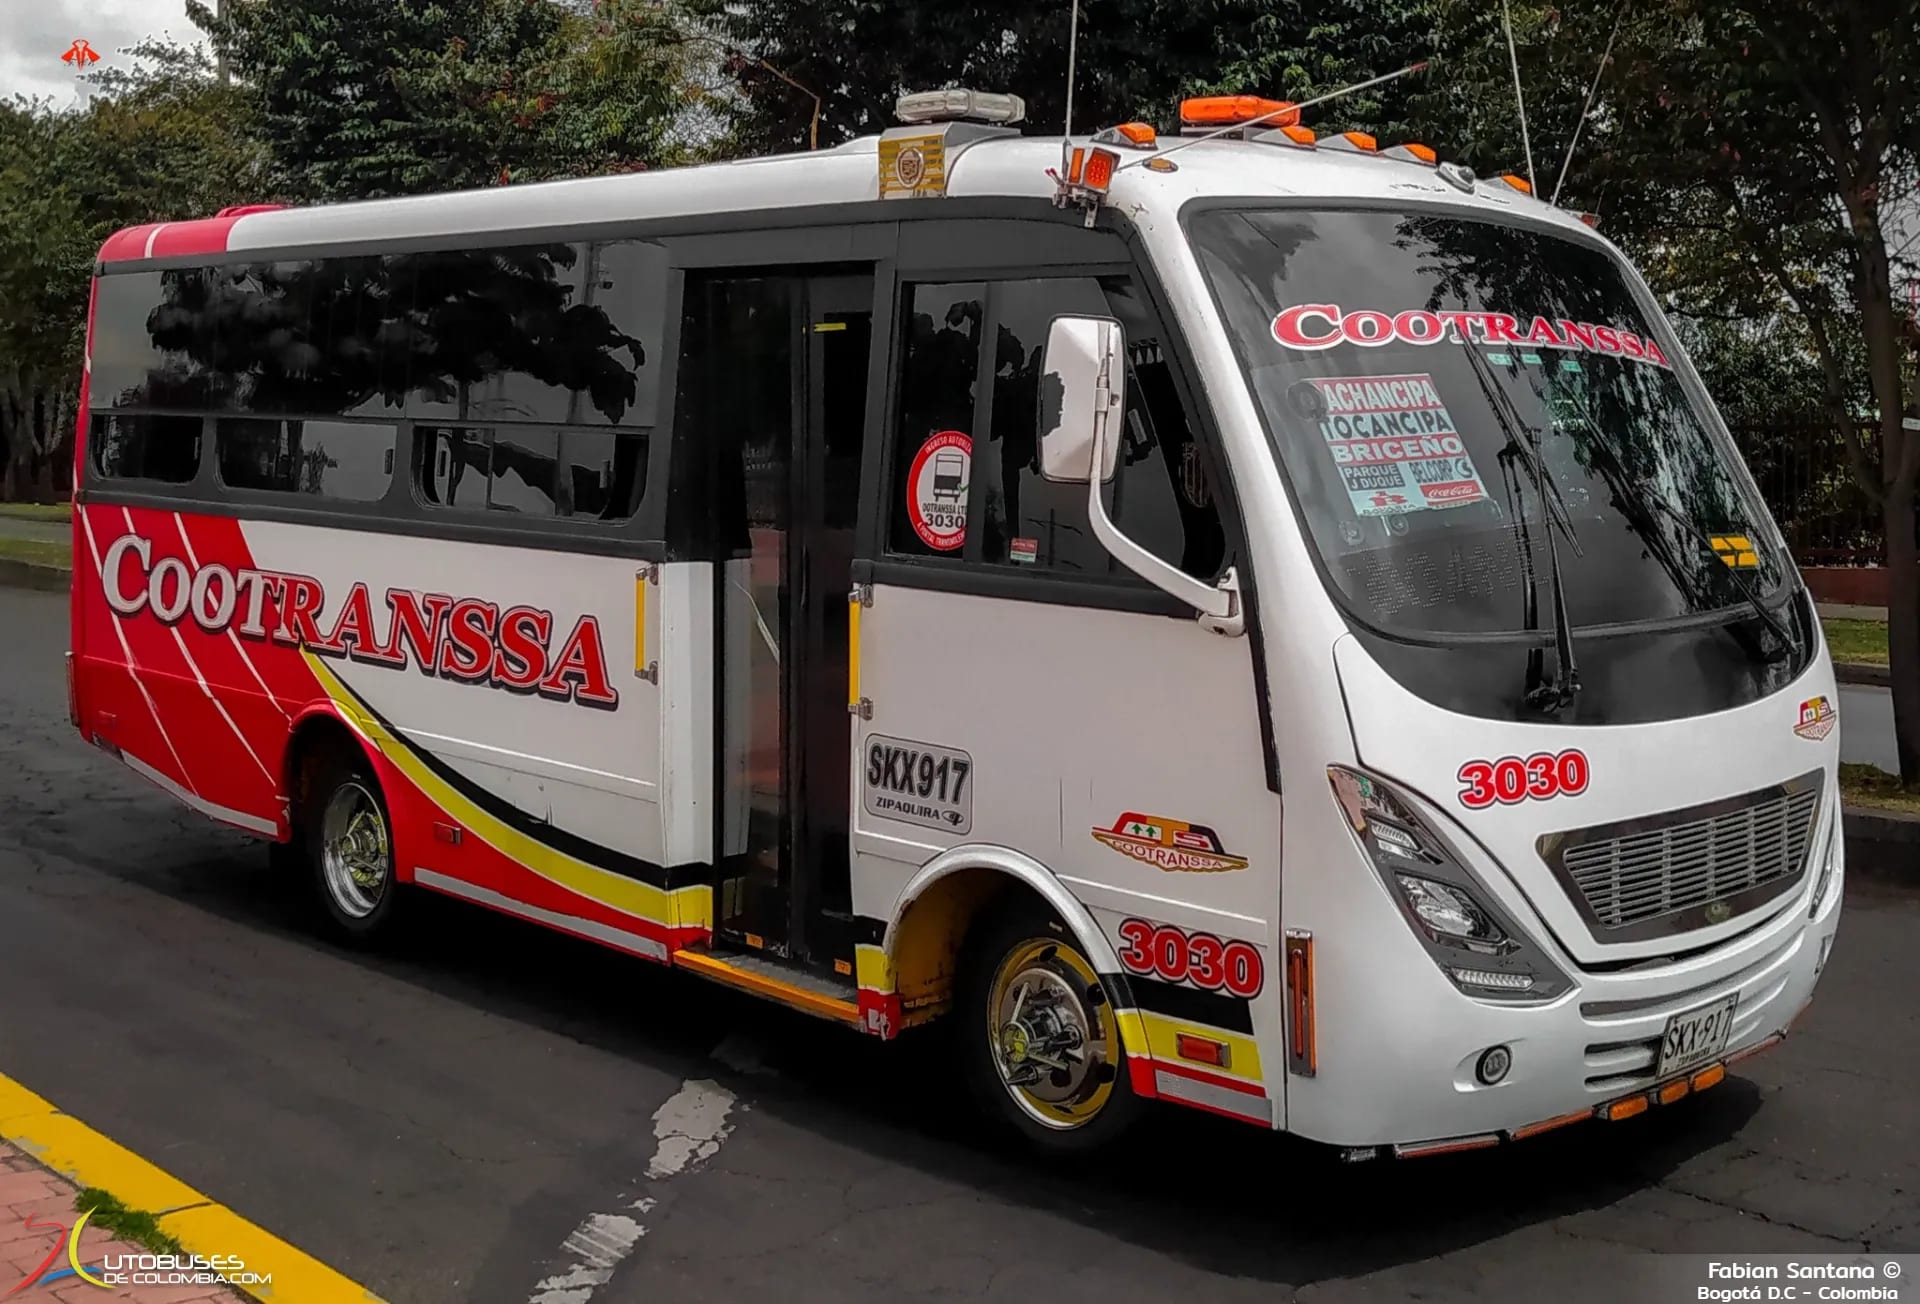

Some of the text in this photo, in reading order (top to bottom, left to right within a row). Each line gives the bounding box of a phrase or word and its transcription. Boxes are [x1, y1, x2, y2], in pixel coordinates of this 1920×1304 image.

[1270, 303, 1671, 370] COOTRANSSA
[1322, 379, 1442, 412] ACHANCIPA
[1329, 436, 1466, 463] BRICEÑO
[1344, 463, 1400, 479] PARQUE
[1350, 474, 1404, 490] J DUQUE
[925, 512, 965, 529] 3030
[101, 532, 619, 712] COOTRANSSA
[868, 743, 970, 805] SKX917
[1457, 748, 1590, 810] 3030
[875, 796, 940, 820] ZIPAQUIRA
[1112, 839, 1224, 868] COOTRANSSA
[1118, 917, 1265, 999] 3030
[1665, 1004, 1734, 1060] SKX-917
